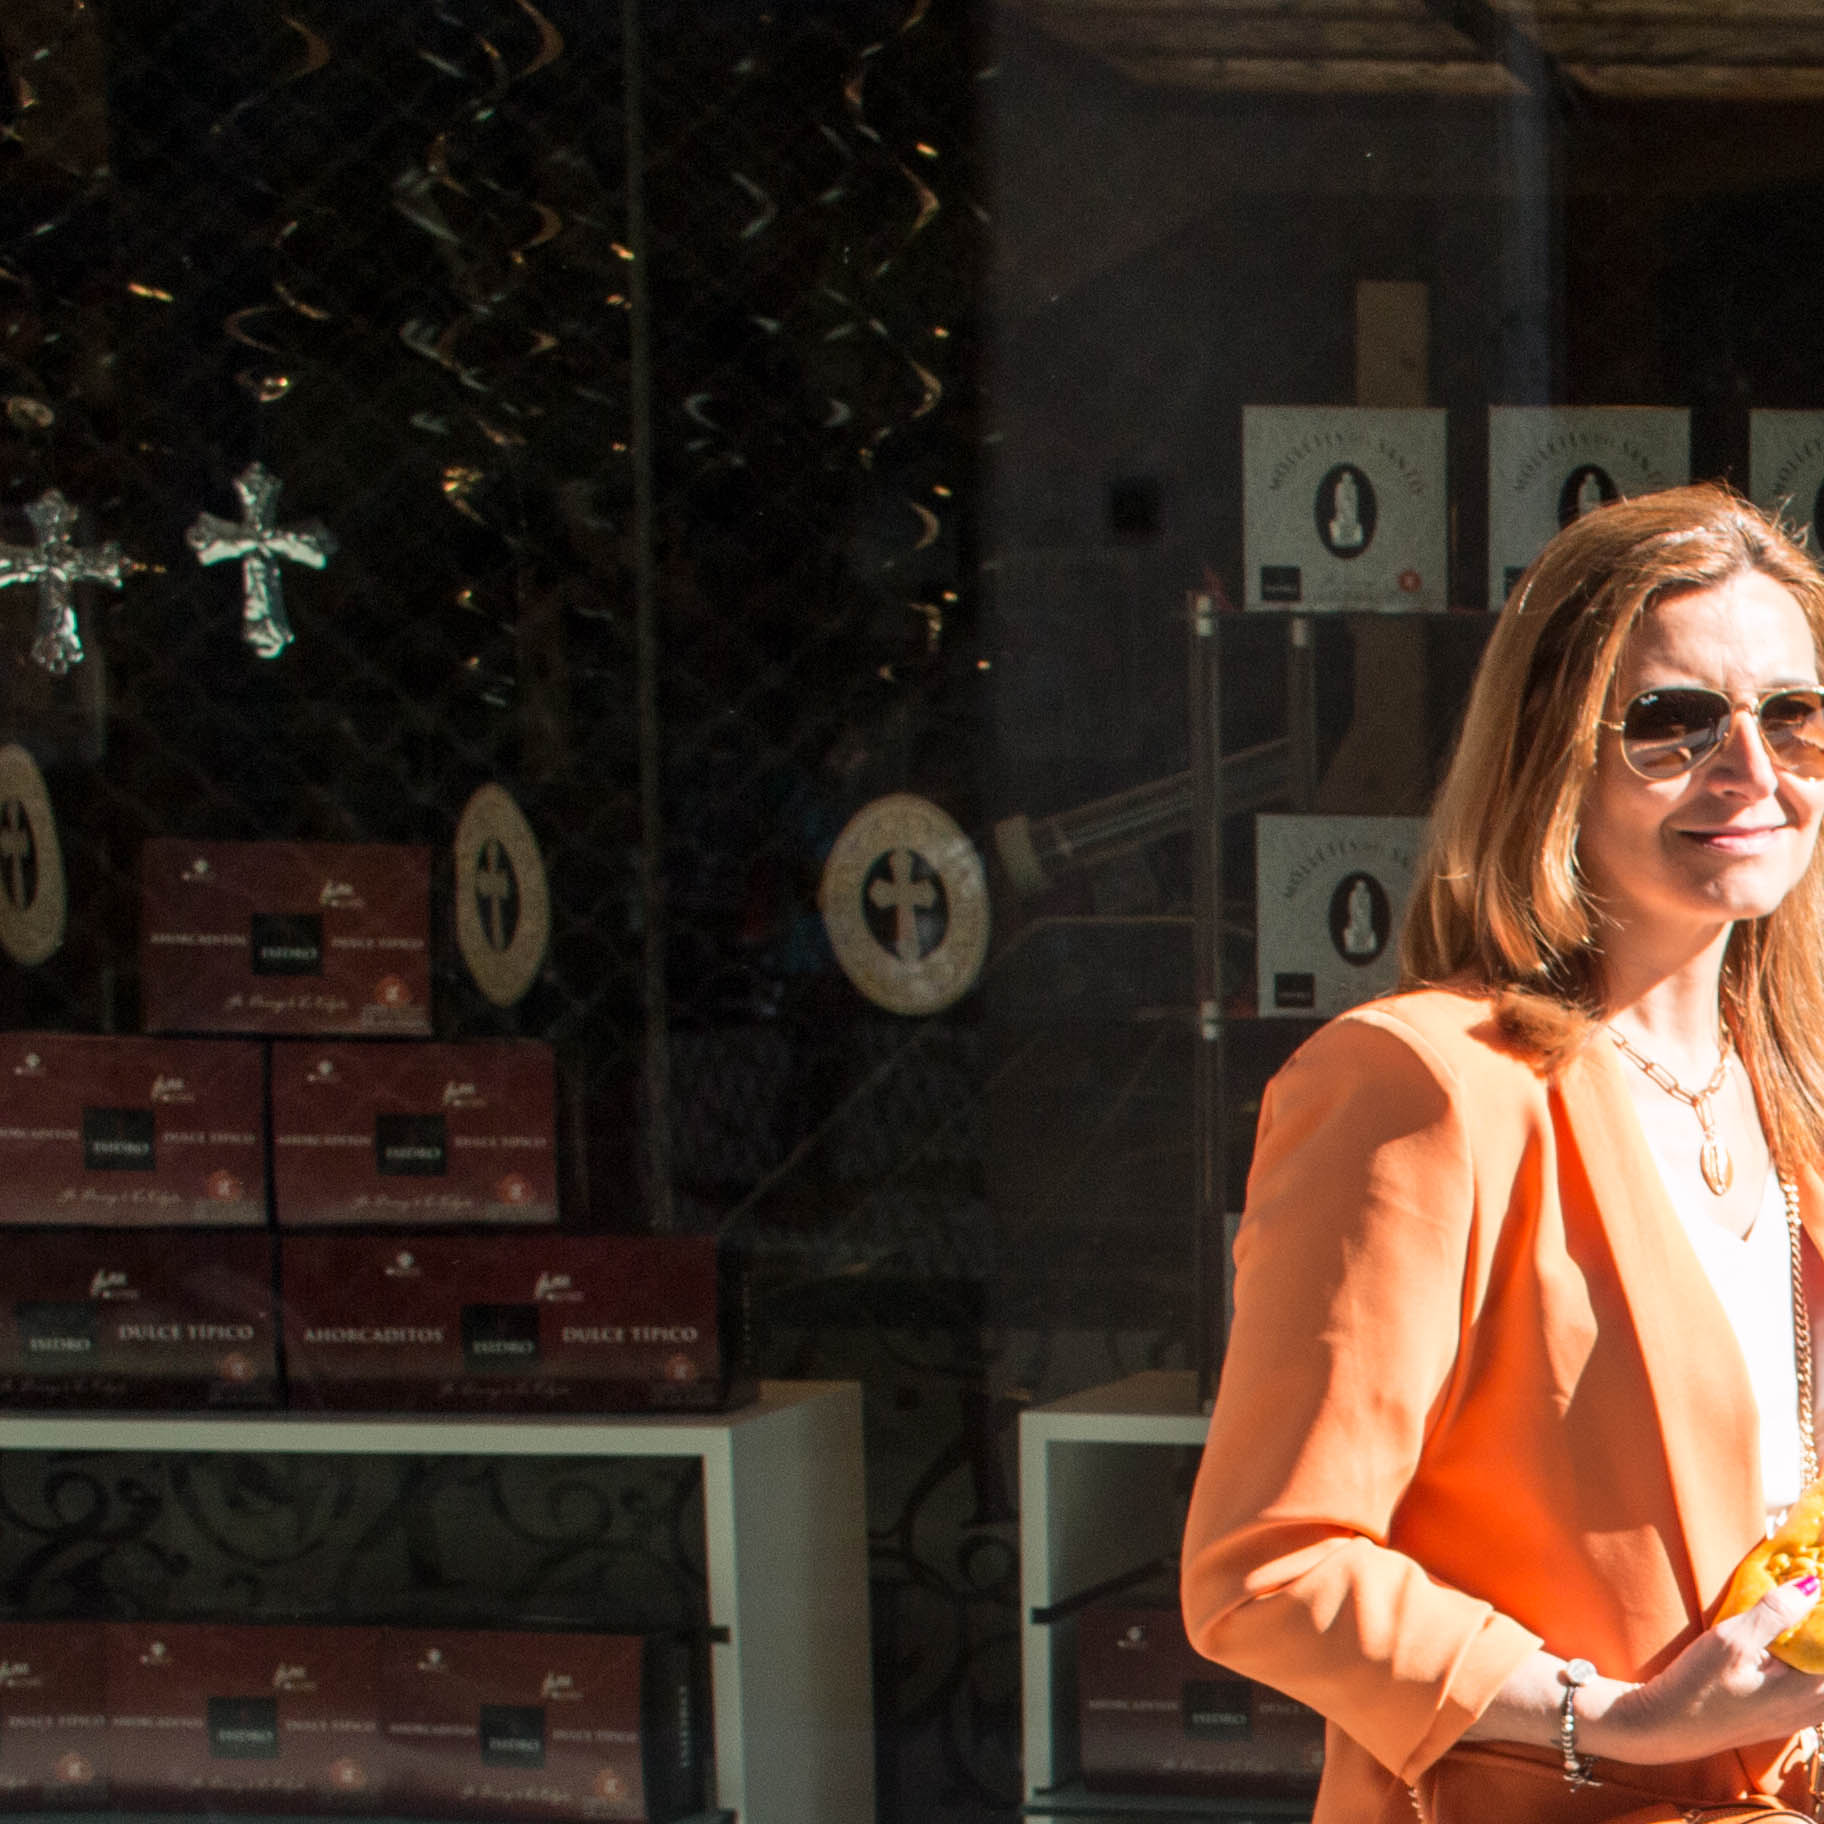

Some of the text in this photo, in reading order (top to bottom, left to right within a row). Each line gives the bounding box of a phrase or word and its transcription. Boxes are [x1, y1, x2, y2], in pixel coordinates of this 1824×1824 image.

[118, 1323, 183, 1342] DULCE
[305, 1326, 444, 1344] AHORCADITOS
[562, 1326, 625, 1344] DULCE
